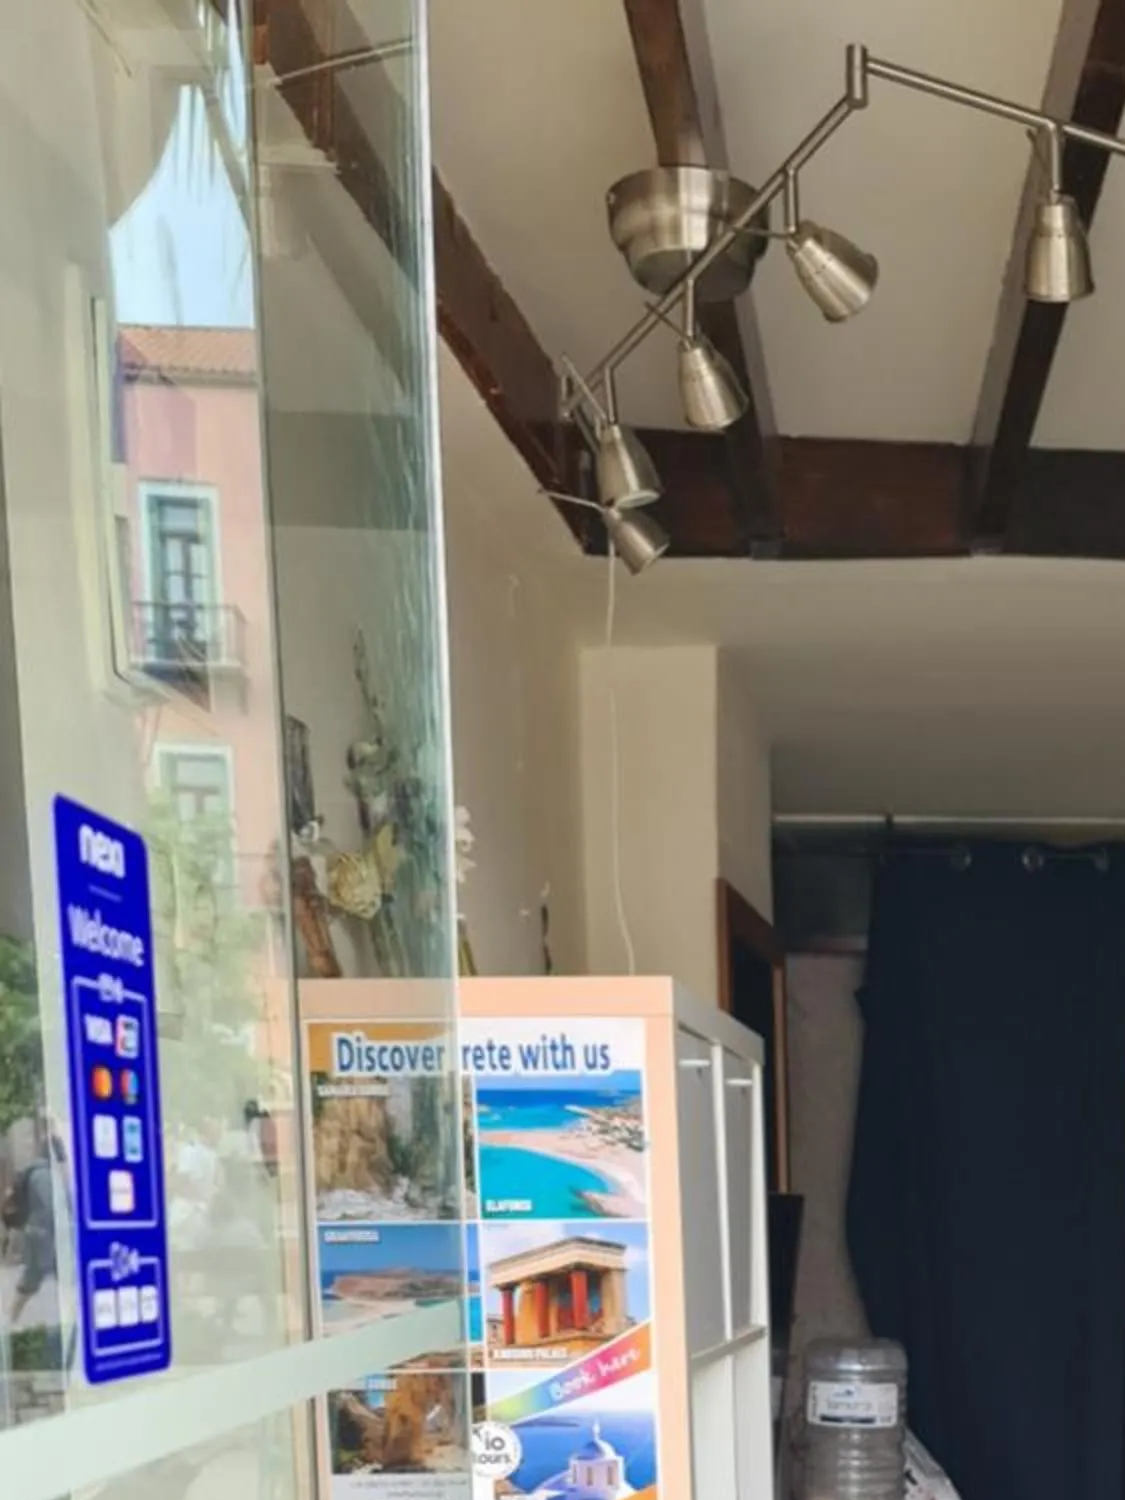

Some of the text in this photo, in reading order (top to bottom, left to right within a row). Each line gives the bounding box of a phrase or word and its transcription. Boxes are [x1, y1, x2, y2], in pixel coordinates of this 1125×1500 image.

[67, 902, 145, 968] Welcome
[336, 1034, 611, 1072] Discover rete with us
[548, 1366, 597, 1402] Book
[484, 1431, 506, 1451] io
